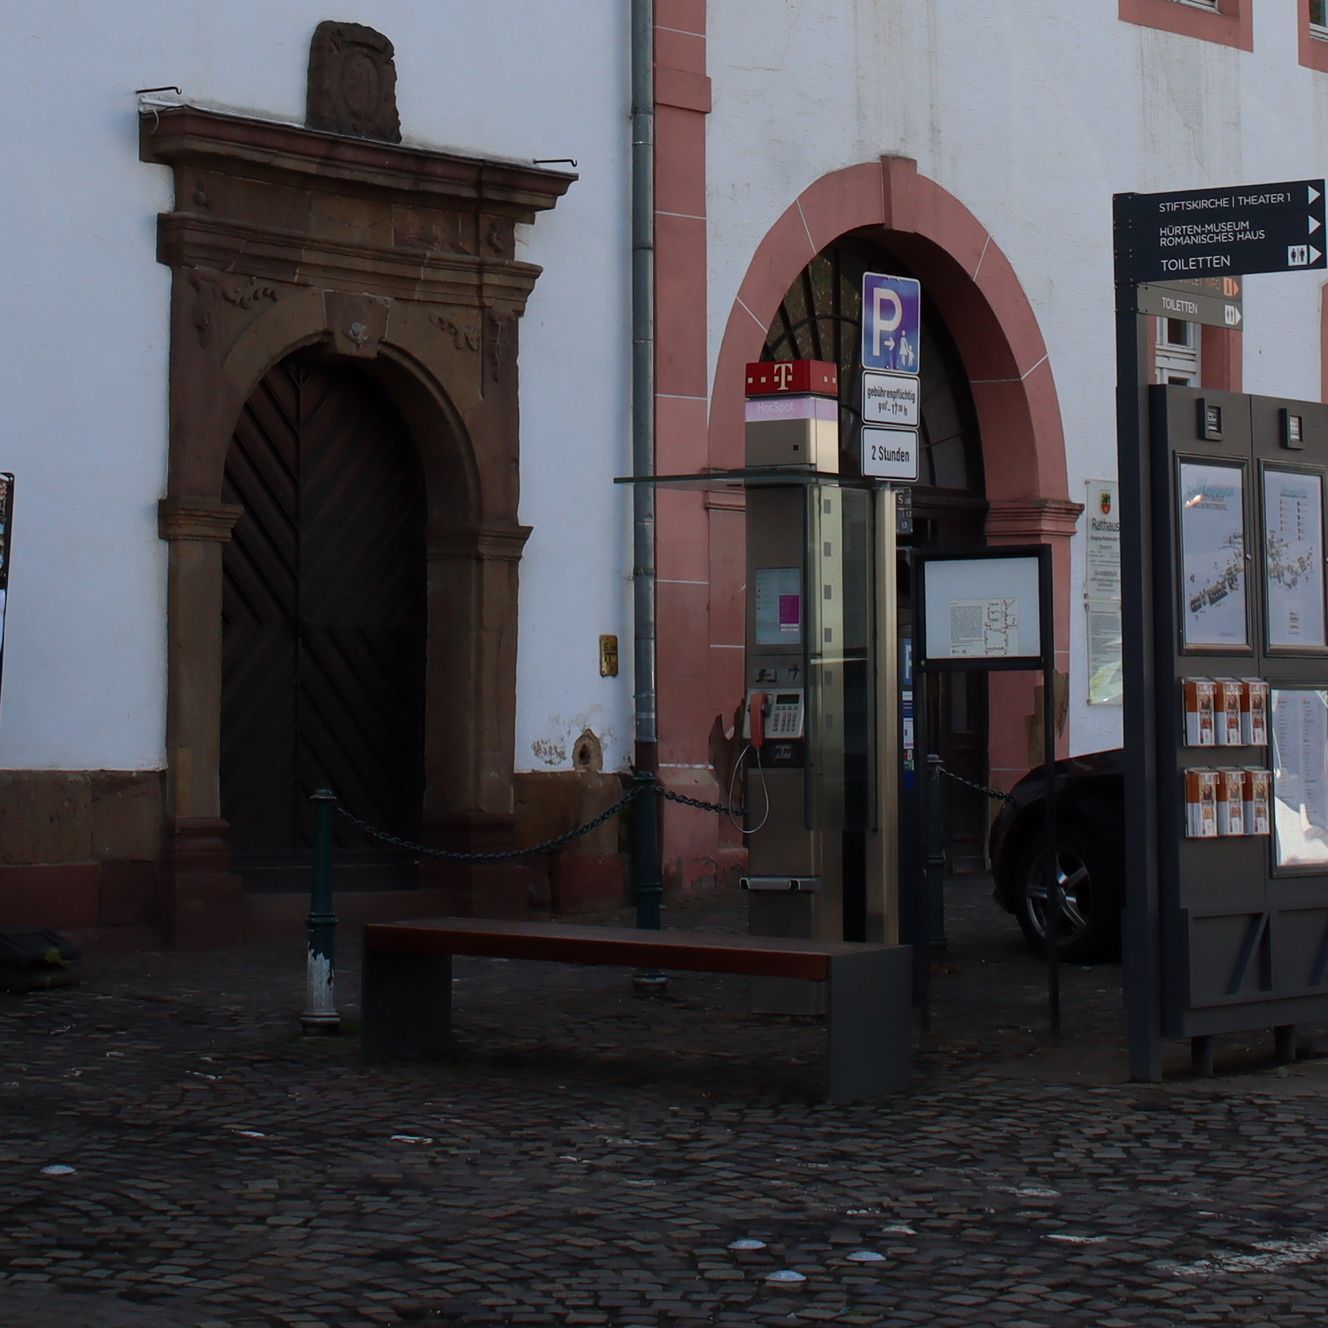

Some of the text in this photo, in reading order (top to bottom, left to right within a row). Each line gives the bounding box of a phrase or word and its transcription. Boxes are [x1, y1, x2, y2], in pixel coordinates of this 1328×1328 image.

[1159, 197, 1229, 213] STIFTSKIRCHE
[1237, 193, 1285, 206] THEATER
[1287, 192, 1291, 203] 1
[1159, 220, 1250, 237] HÜRTEN-MUSEUM
[1159, 229, 1266, 247] ROMANISCHES HAUS
[1160, 254, 1231, 271] TOILETTEN
[1161, 296, 1198, 314] TOILETTEN
[872, 287, 903, 357] P
[867, 385, 916, 404] gebührenpflichtig
[871, 445, 910, 463] 2 Stunden
[1091, 517, 1121, 532] Rathaus
